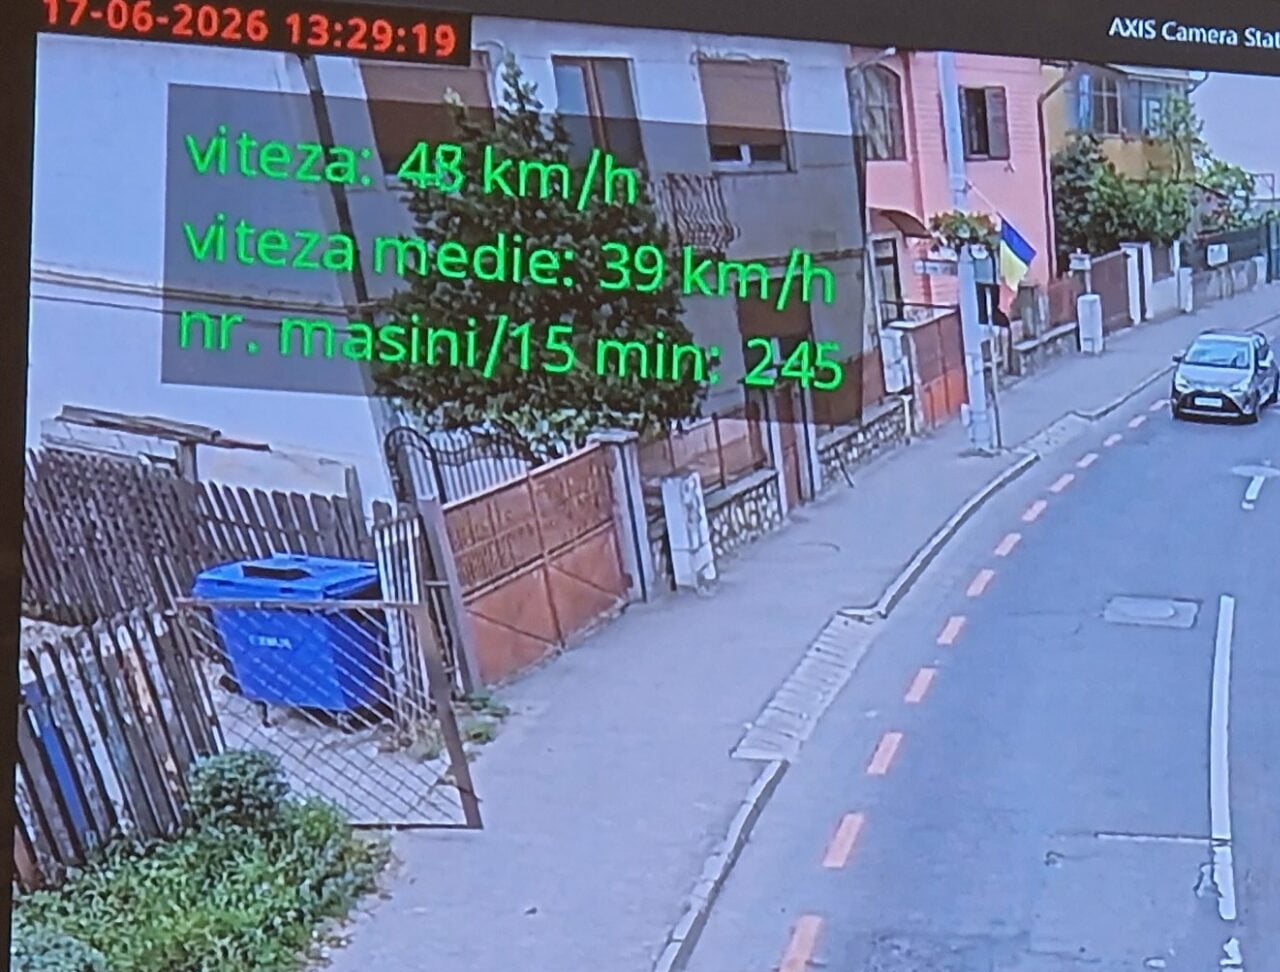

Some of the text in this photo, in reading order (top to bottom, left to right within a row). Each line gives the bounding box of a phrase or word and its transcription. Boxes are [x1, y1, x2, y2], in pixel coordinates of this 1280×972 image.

[43, 0, 456, 57] 17-06-2026 13:29:19
[1108, 16, 1157, 40] AXIS
[1161, 21, 1238, 46] Camera
[186, 124, 636, 210] viteza: 48 km/h
[184, 212, 836, 311] viteza medie: 39 km/h
[180, 311, 843, 390] nr. masini/15 min: 245
